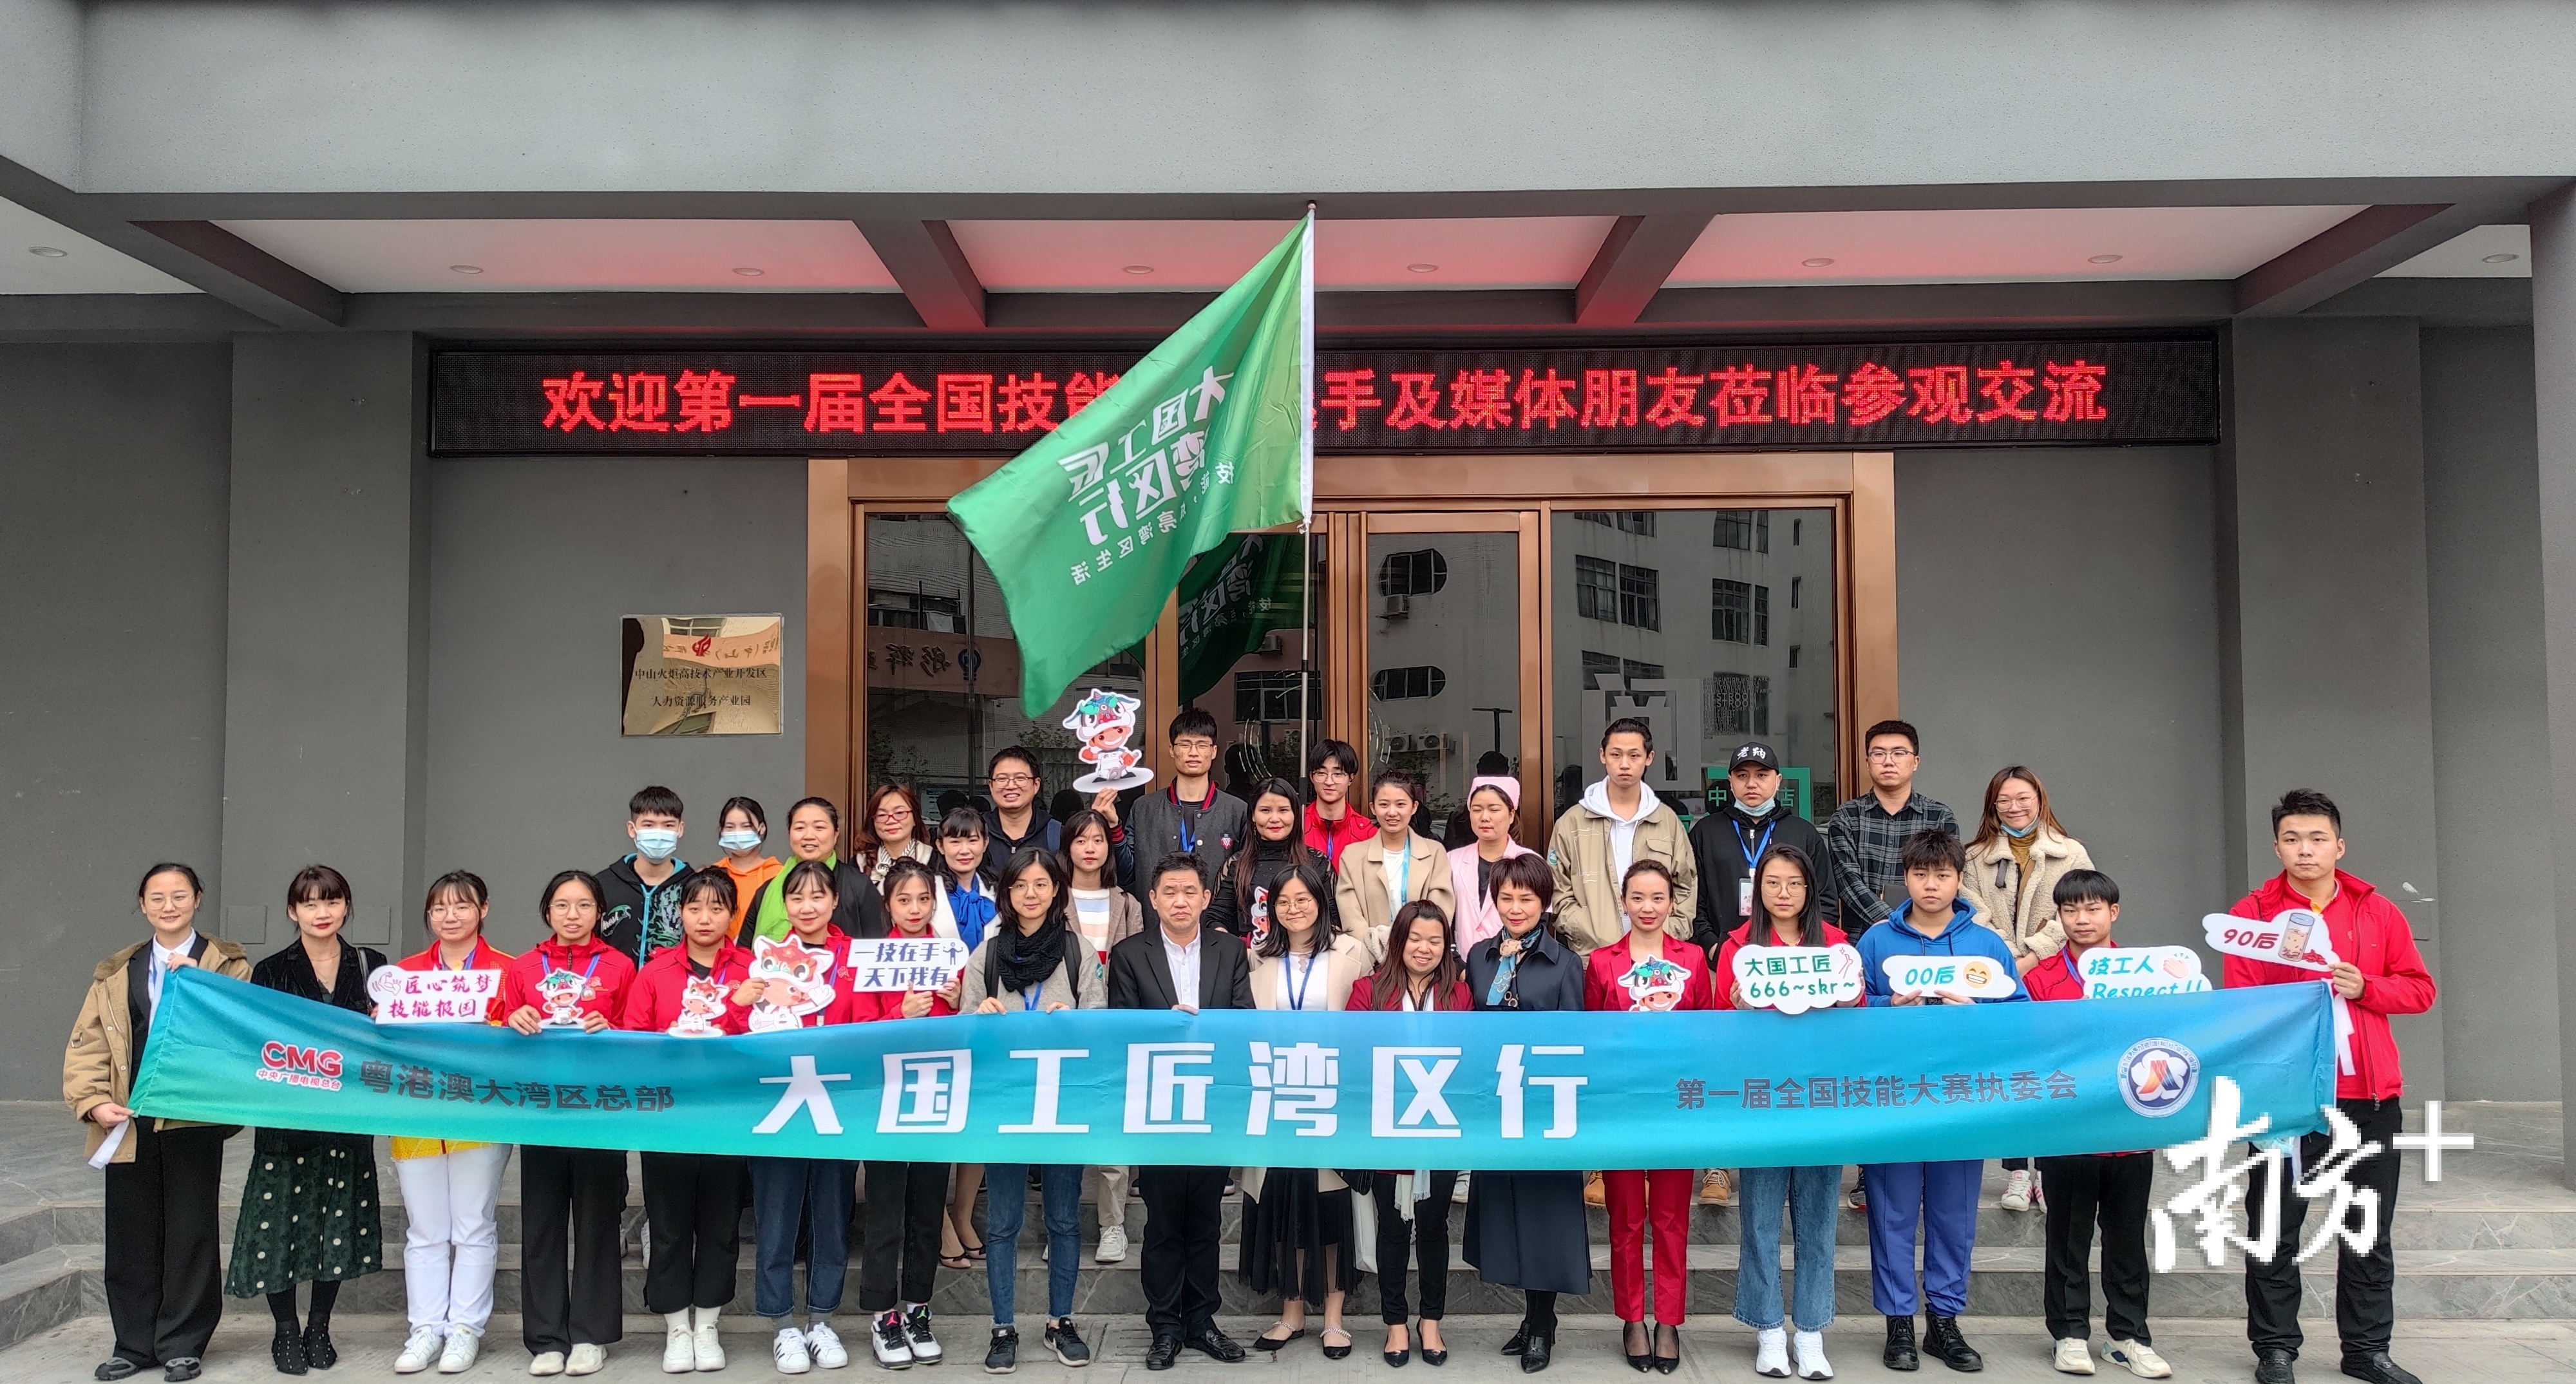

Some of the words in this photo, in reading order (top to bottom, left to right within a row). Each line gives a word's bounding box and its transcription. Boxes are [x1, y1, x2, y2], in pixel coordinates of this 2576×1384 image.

[542, 362, 2107, 433] 欢迎第一届全国技能手及媒体朋友莅临参观交流
[635, 668, 767, 679] 中山火炬高技术产业开发区
[652, 695, 751, 707] 人力资源服务产业园
[2224, 929, 2280, 950] 90后
[855, 942, 940, 963] 一技在手
[1745, 954, 1832, 977] 大国工匠
[1905, 965, 1956, 986] 00后
[2088, 955, 2154, 976] 技工人
[405, 974, 493, 994] 匠心筑梦
[864, 967, 950, 988] 天下我有
[388, 999, 477, 1019] 技能报国
[263, 1042, 342, 1077] CMG
[258, 1069, 341, 1090] 中央广播电视总台
[359, 1060, 676, 1113] 粤港澳大湾区总部
[1674, 1069, 2079, 1110] 第一届全国技能大赛执委会
[752, 1042, 1588, 1139] 大国工匠湾区行
